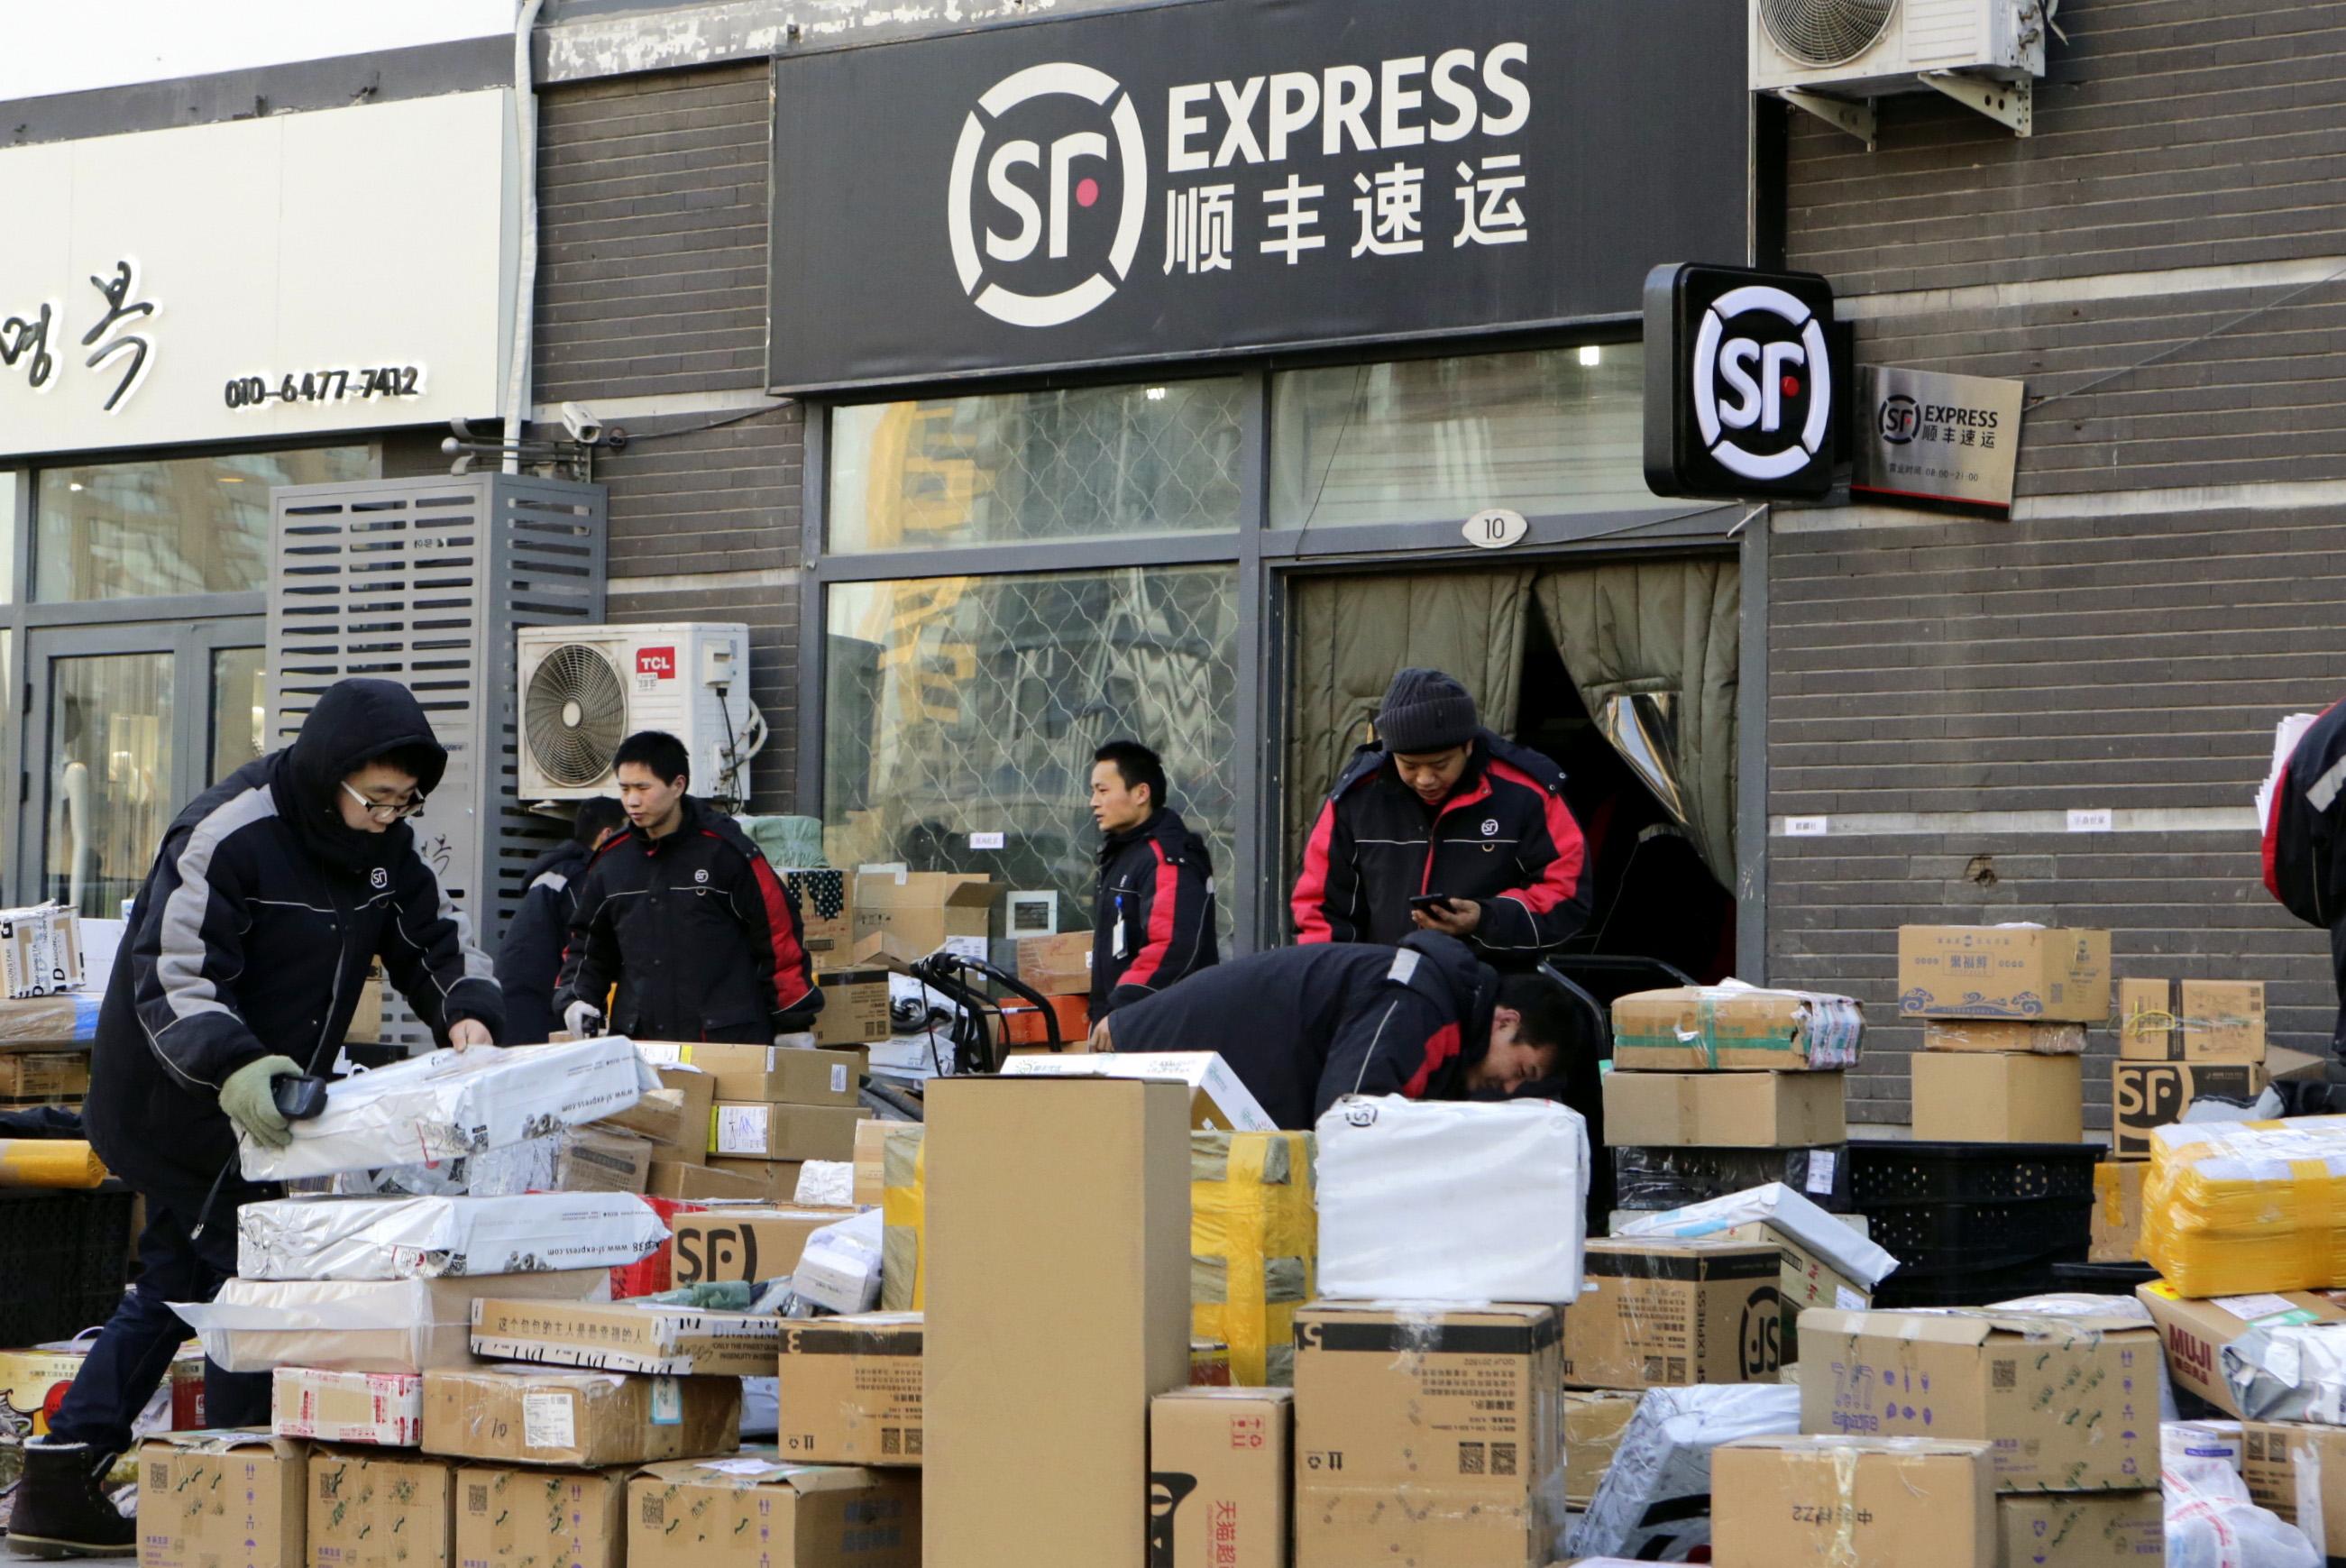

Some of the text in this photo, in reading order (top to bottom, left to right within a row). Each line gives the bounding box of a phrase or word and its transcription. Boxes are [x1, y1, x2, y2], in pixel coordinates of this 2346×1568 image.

[1168, 41, 1531, 172] EXPRESS
[986, 132, 1107, 261] SF
[1163, 153, 1528, 275] 顺丰速运
[1718, 337, 1804, 432] SF
[1921, 424, 1995, 449] 顺丰速运
[1925, 405, 1998, 428] EXPRESS
[1484, 518, 1505, 539] 10
[641, 656, 670, 669] TCL
[2119, 1069, 2175, 1115] SF
[547, 1244, 628, 1257] www.sf-express.com
[677, 1227, 737, 1282] SF
[1698, 1289, 1707, 1359] EXPRESS
[2168, 1323, 2212, 1371] MUJI
